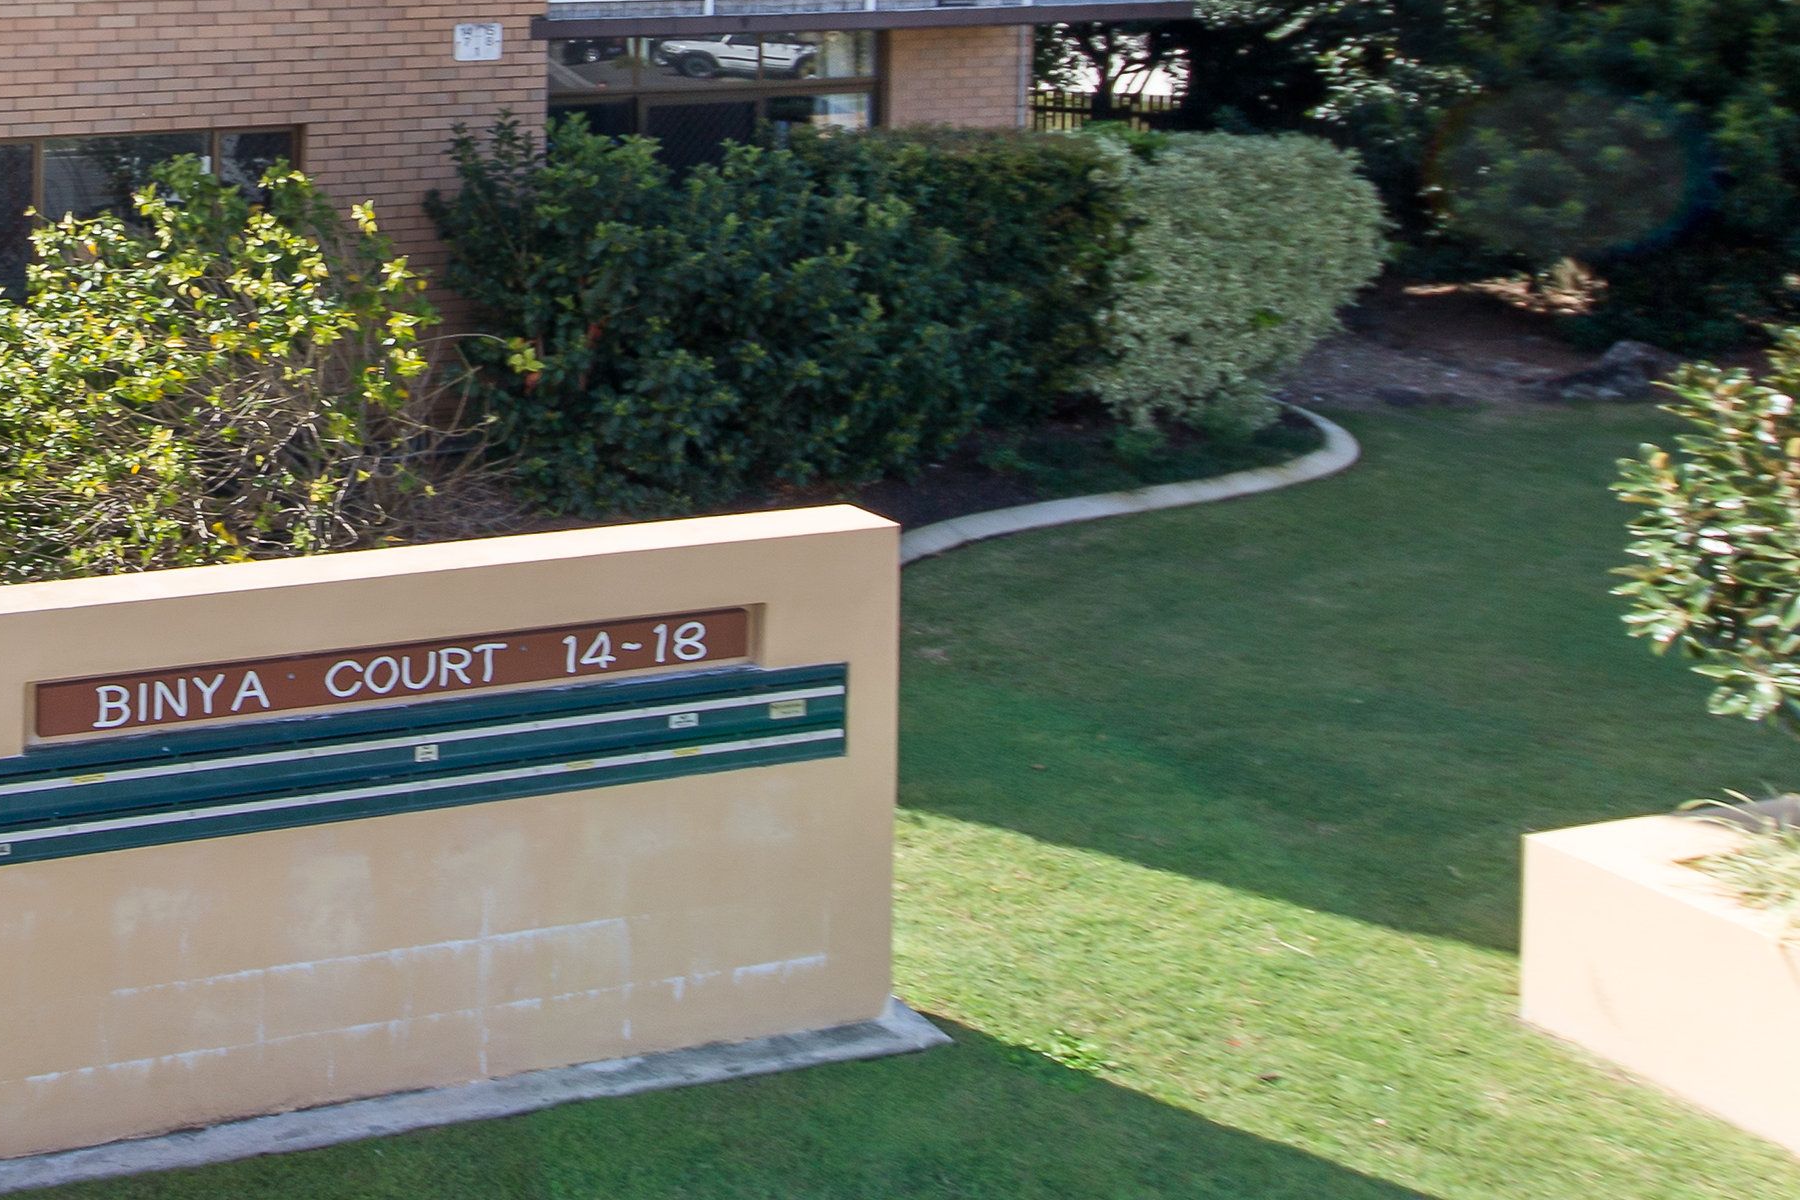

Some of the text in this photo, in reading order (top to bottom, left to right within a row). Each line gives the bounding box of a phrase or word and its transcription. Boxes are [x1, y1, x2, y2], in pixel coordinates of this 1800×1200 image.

[92, 621, 708, 728] BINYA COURT 14-18
